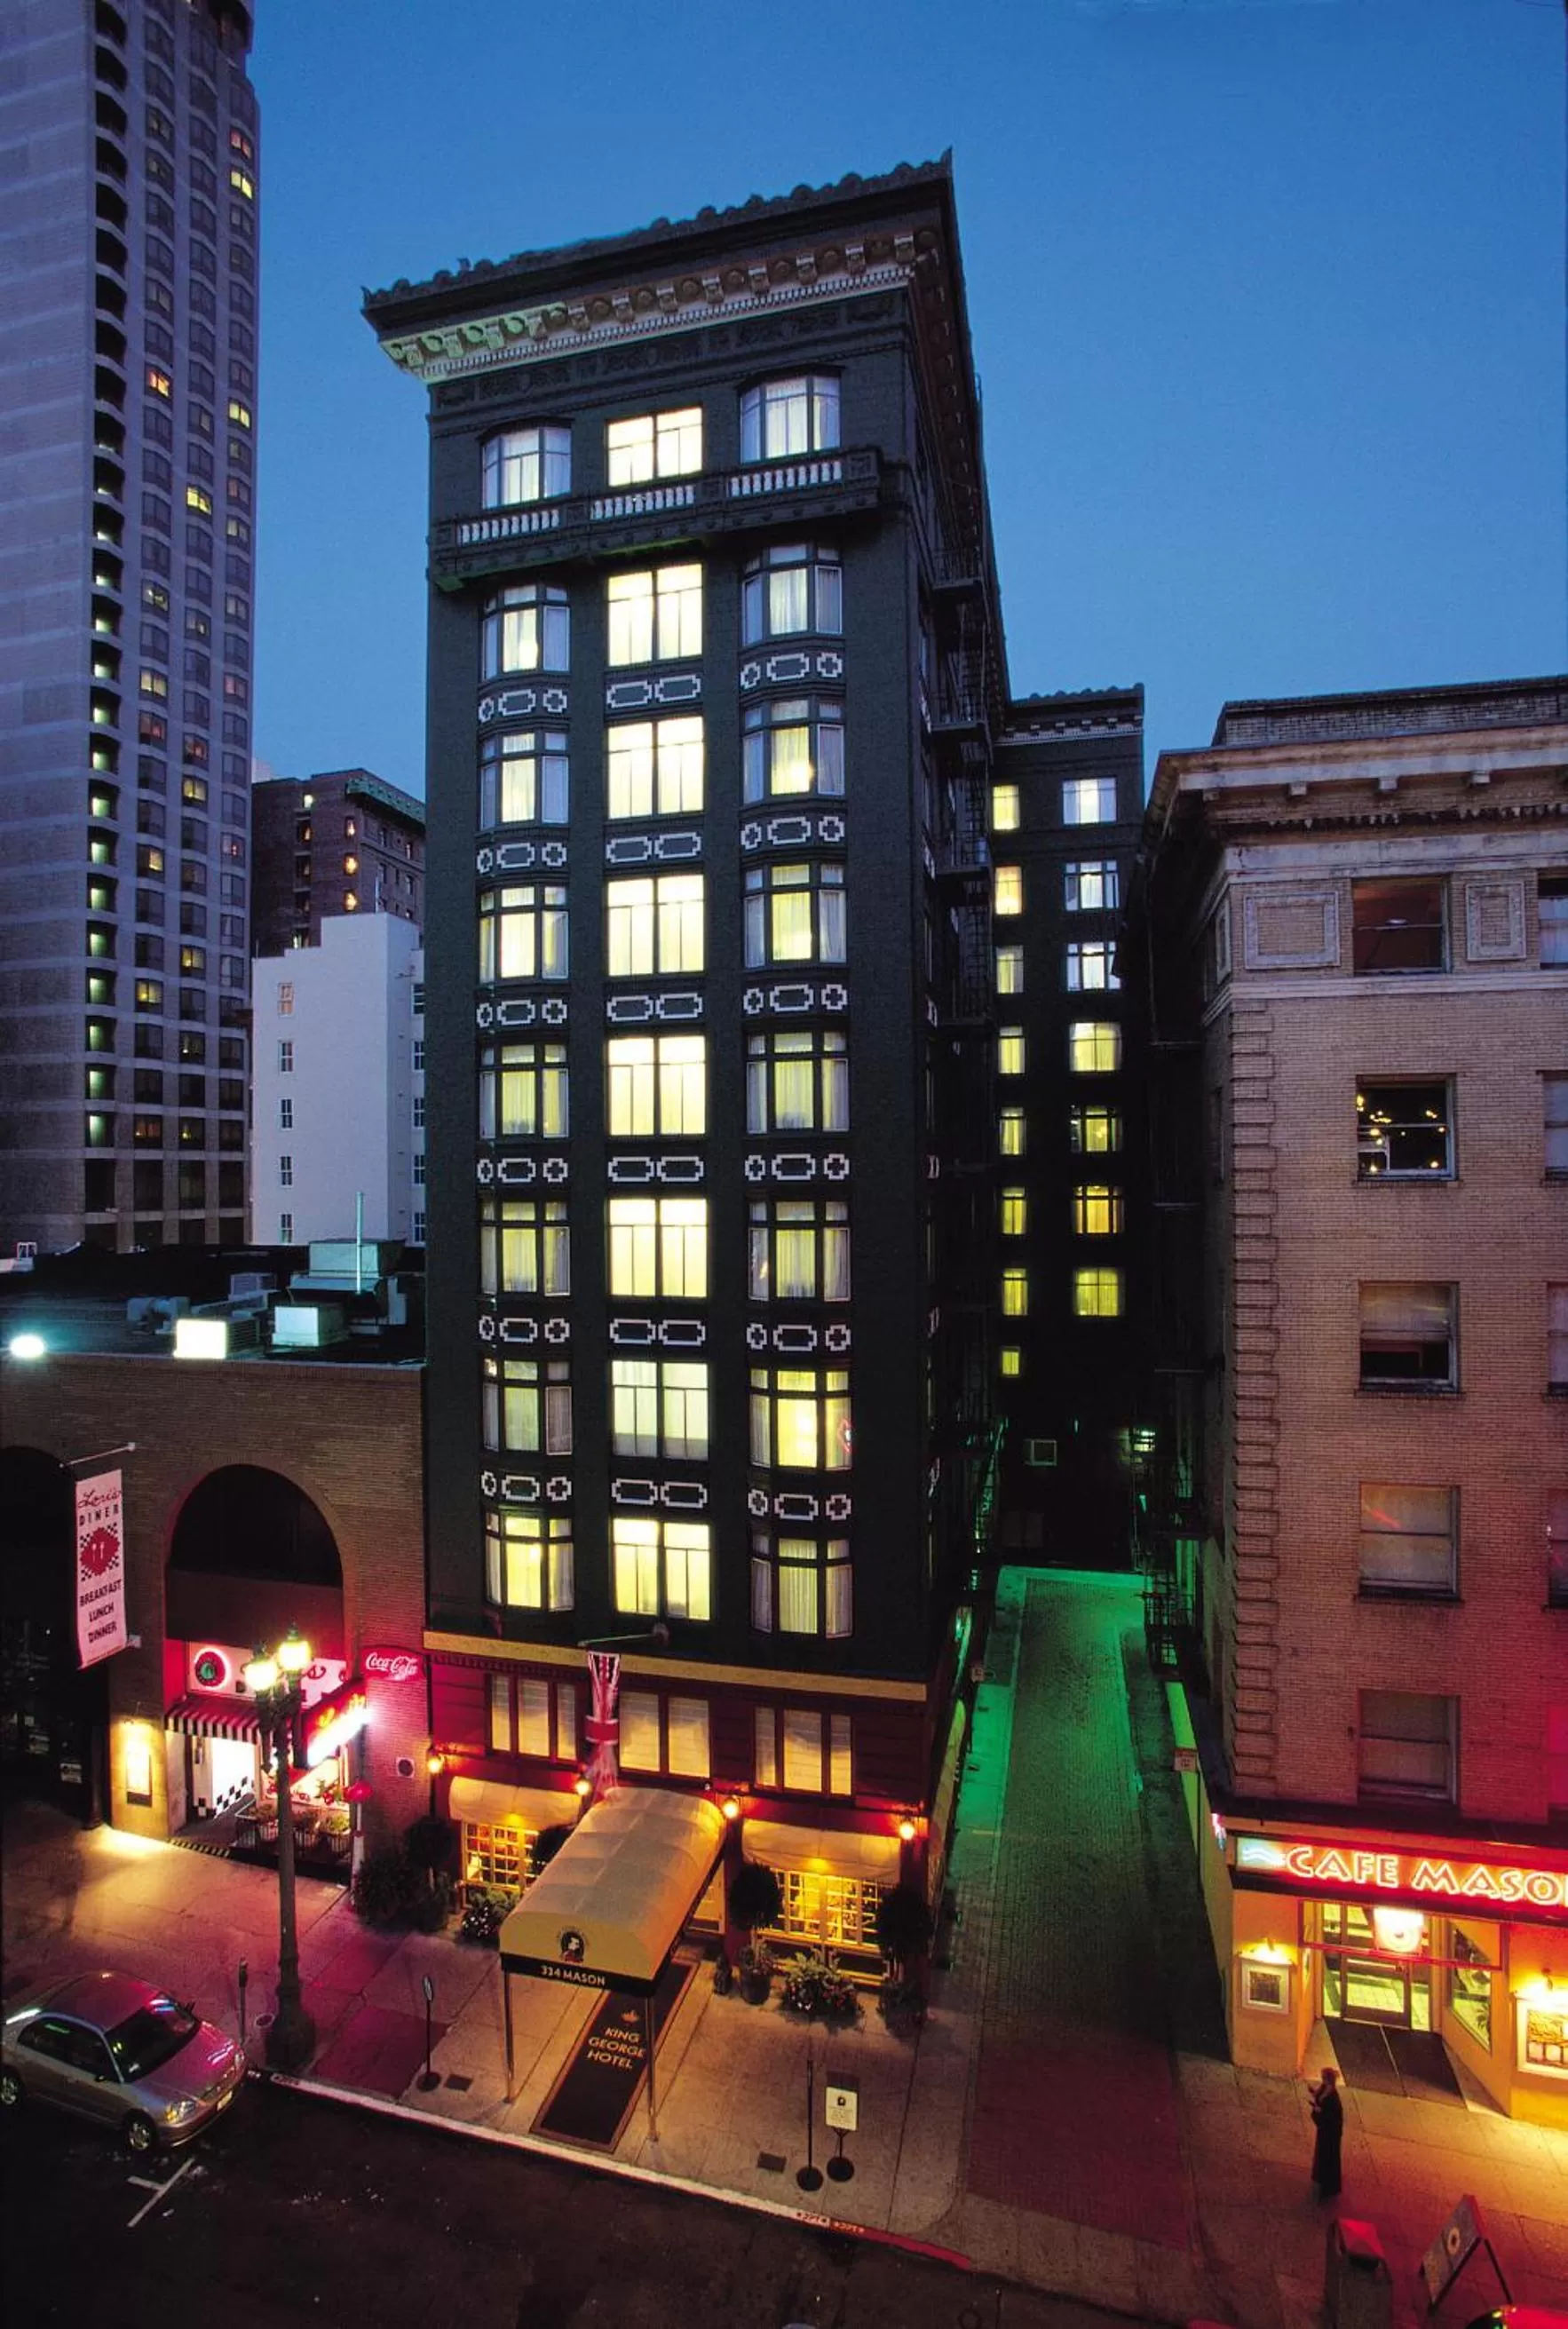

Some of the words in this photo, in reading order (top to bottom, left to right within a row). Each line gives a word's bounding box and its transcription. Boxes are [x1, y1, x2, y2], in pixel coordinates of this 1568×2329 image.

[79, 1504, 119, 1526] DINER
[80, 1579, 122, 1607] BREAKFAST
[89, 1602, 115, 1622] LUNCH
[88, 1621, 117, 1643] DINNER
[366, 1652, 418, 1677] Coca-Cola
[1287, 1846, 1400, 1889] CAFE
[1412, 1861, 1568, 1907] MASO
[541, 1964, 561, 1977] 334
[563, 1969, 606, 1986] MASON
[605, 2027, 640, 2043] KING
[589, 2037, 646, 2058] GEORGE
[587, 2050, 633, 2070] HOTEL
